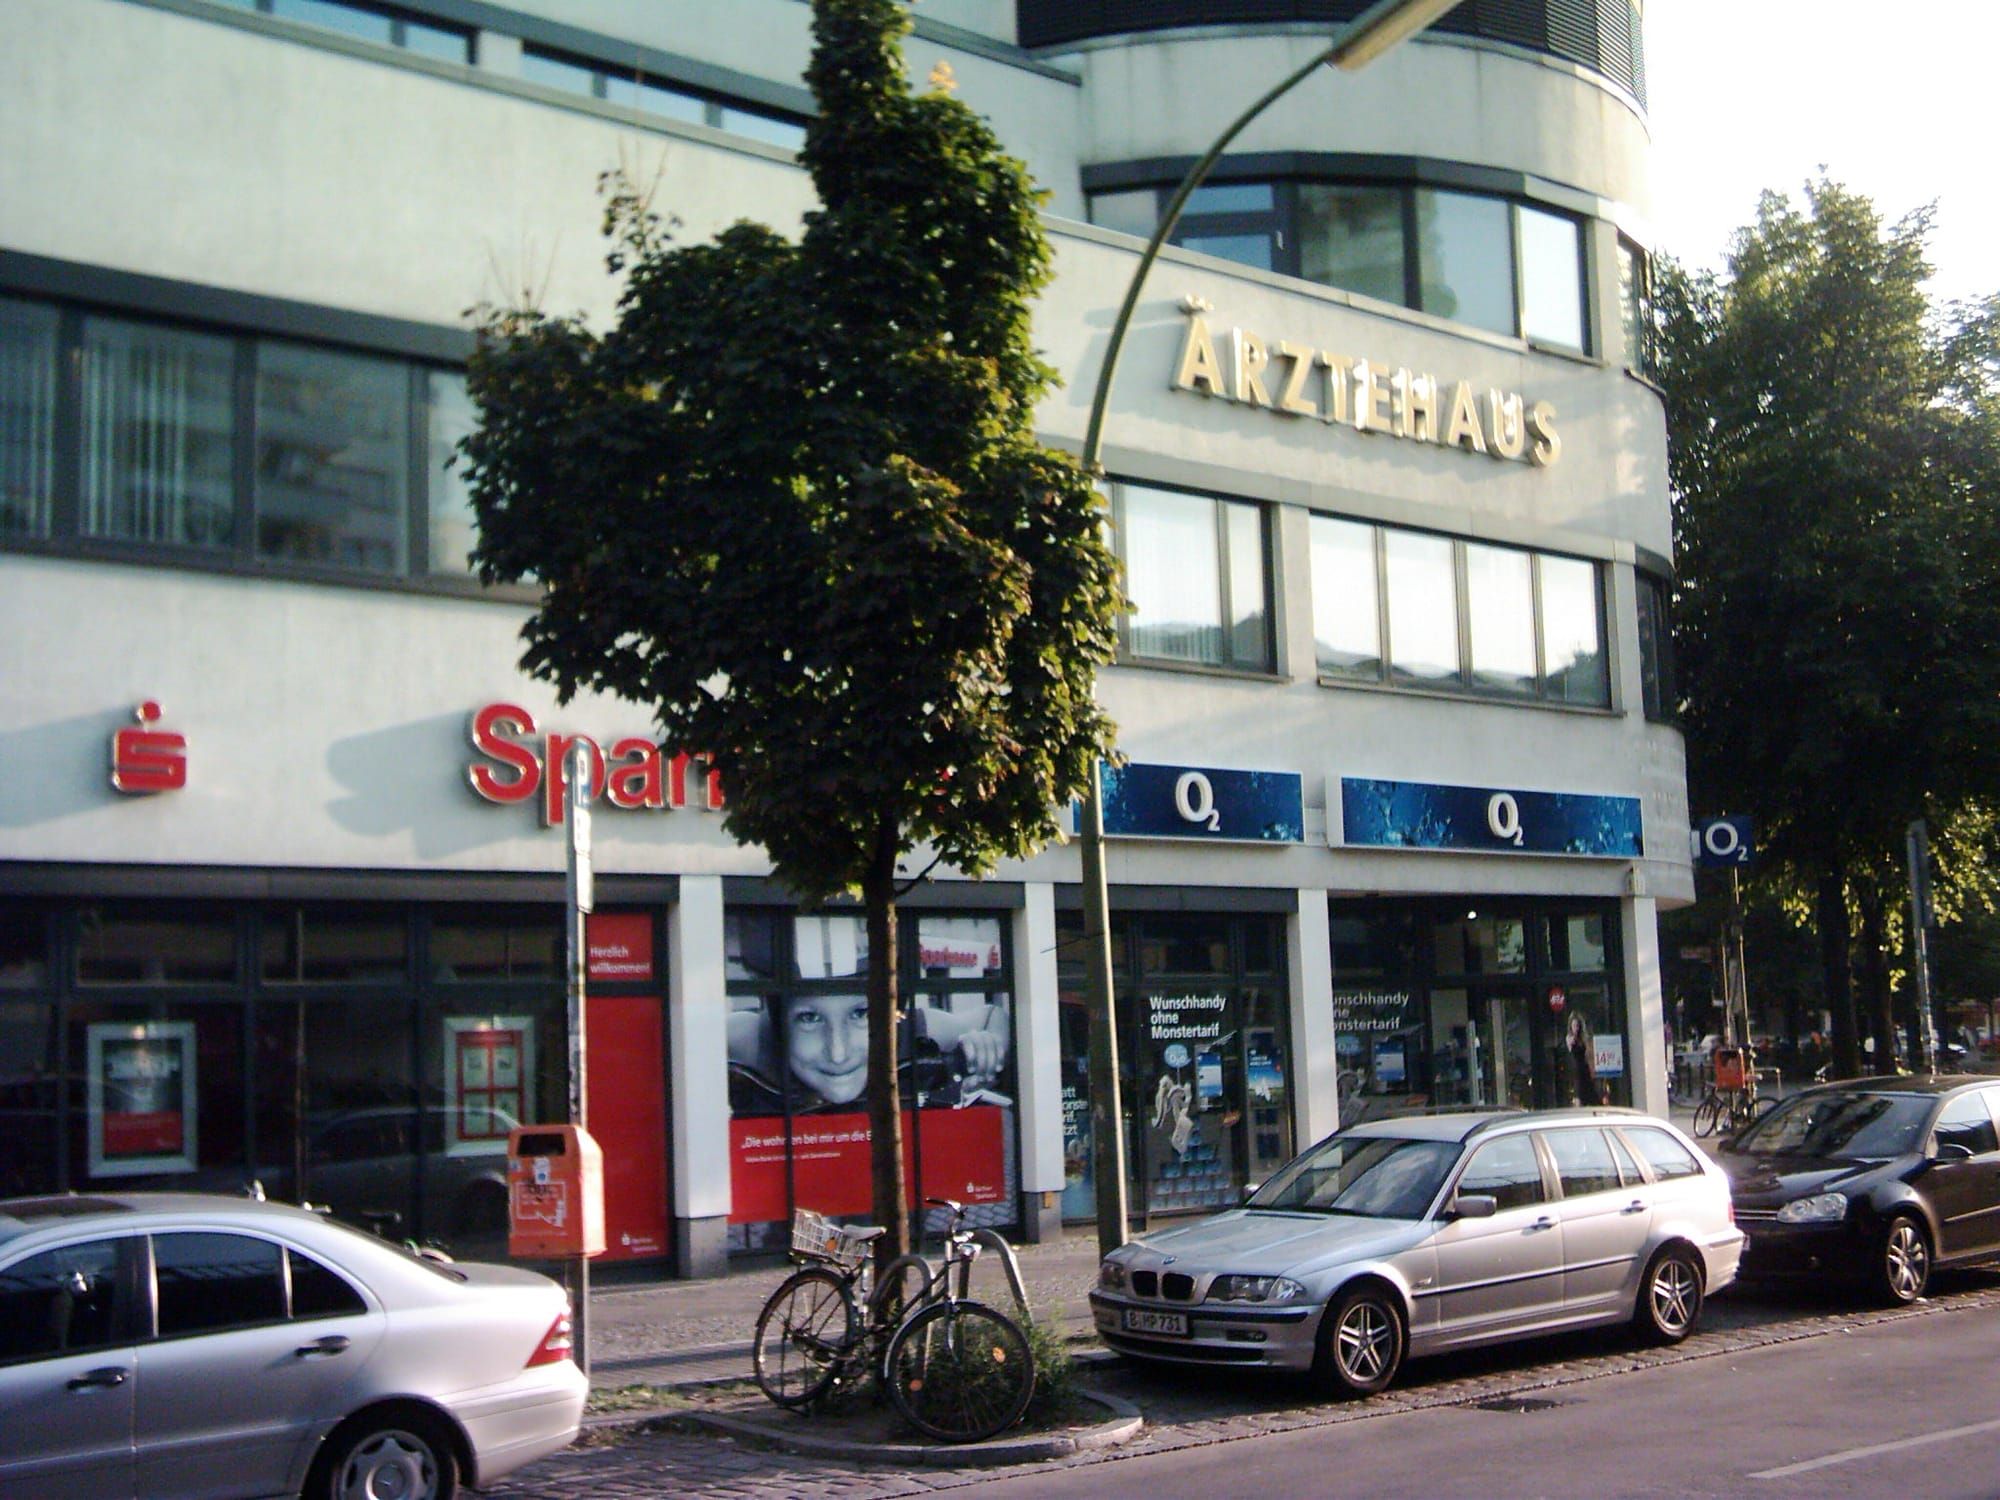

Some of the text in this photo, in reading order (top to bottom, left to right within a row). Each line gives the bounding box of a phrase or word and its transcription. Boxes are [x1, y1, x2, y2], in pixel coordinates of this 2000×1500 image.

[1172, 294, 1563, 467] ÄRZTEHAUS
[590, 945, 629, 958] Herzlich
[1150, 993, 1227, 1012] Wunschhandy
[1150, 1011, 1179, 1025] ohne
[1151, 1022, 1220, 1040] Monstertarif
[804, 1133, 818, 1145] bei
[819, 1132, 835, 1143] mir
[836, 1132, 850, 1143] um
[851, 1129, 866, 1142] die
[1159, 1315, 1182, 1332] 731
